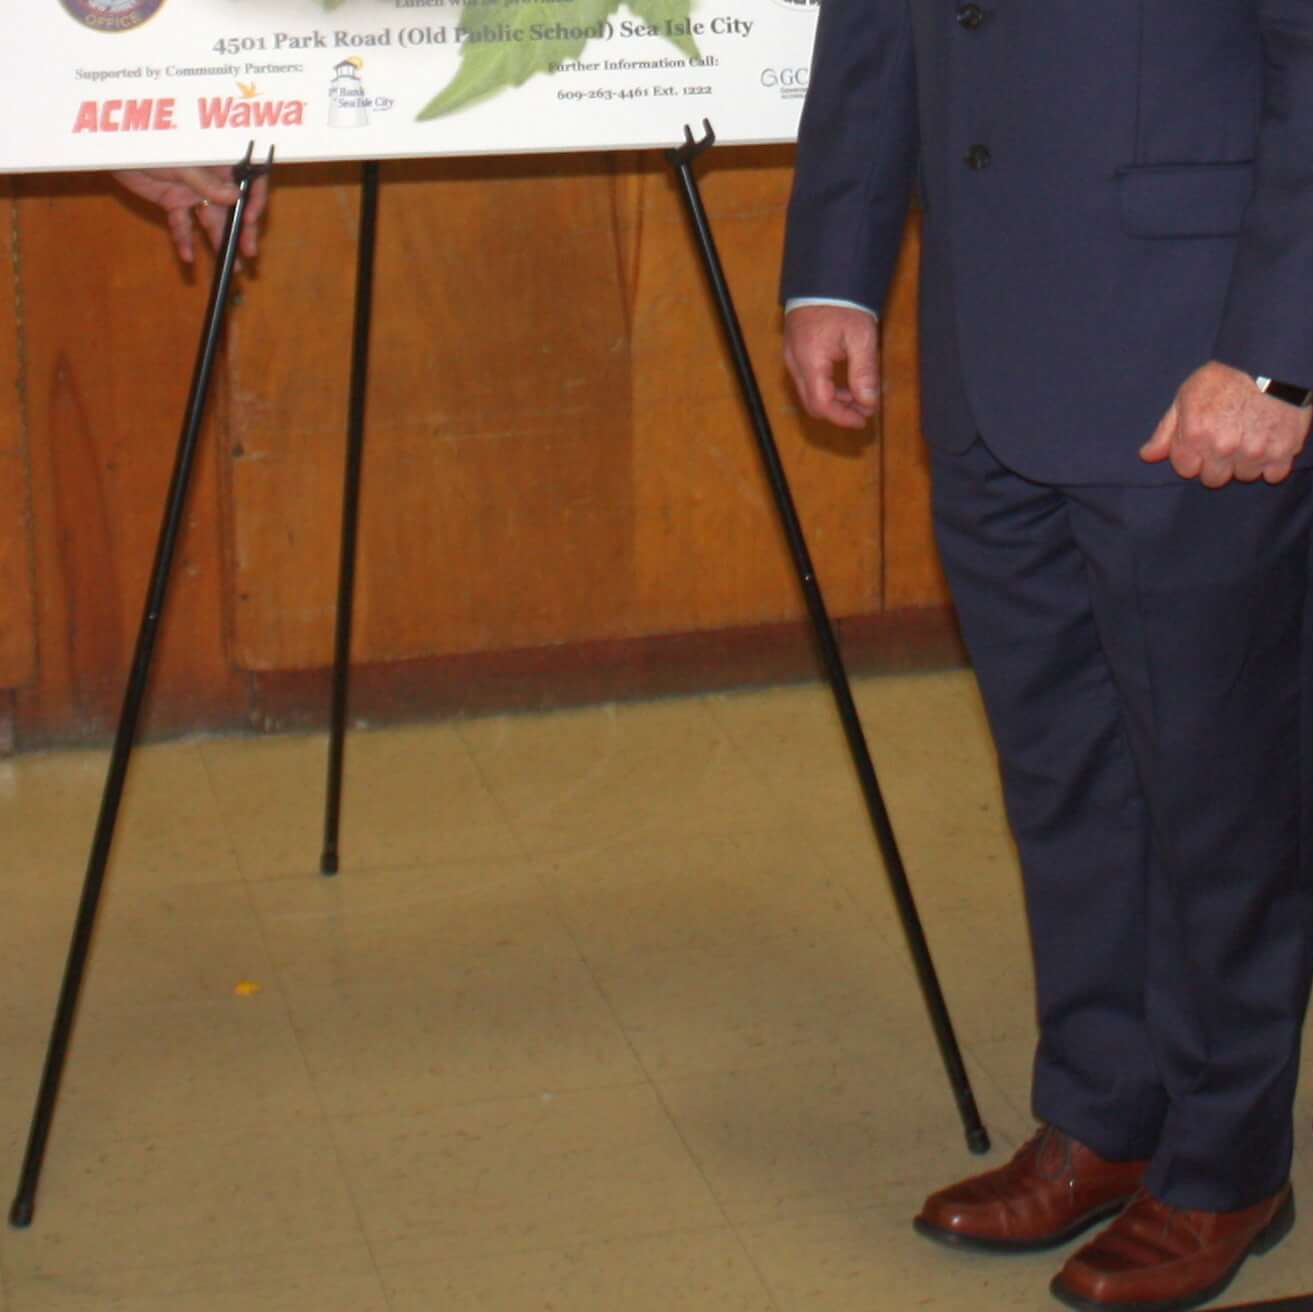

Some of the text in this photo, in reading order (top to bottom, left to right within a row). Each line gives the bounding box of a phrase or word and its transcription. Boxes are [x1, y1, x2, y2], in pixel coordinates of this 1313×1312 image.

[84, 10, 140, 29] OFFICE
[212, 15, 754, 56] 4501 Park Road (Old Public School) Sea Isle City
[74, 61, 305, 82] Supported by Community Partners:
[548, 54, 720, 75] Further Information Call:
[374, 95, 396, 111] City
[557, 85, 713, 101] 609-263-4461 Ext. 1222
[72, 96, 174, 133] ACME
[196, 95, 306, 130] Wawa
